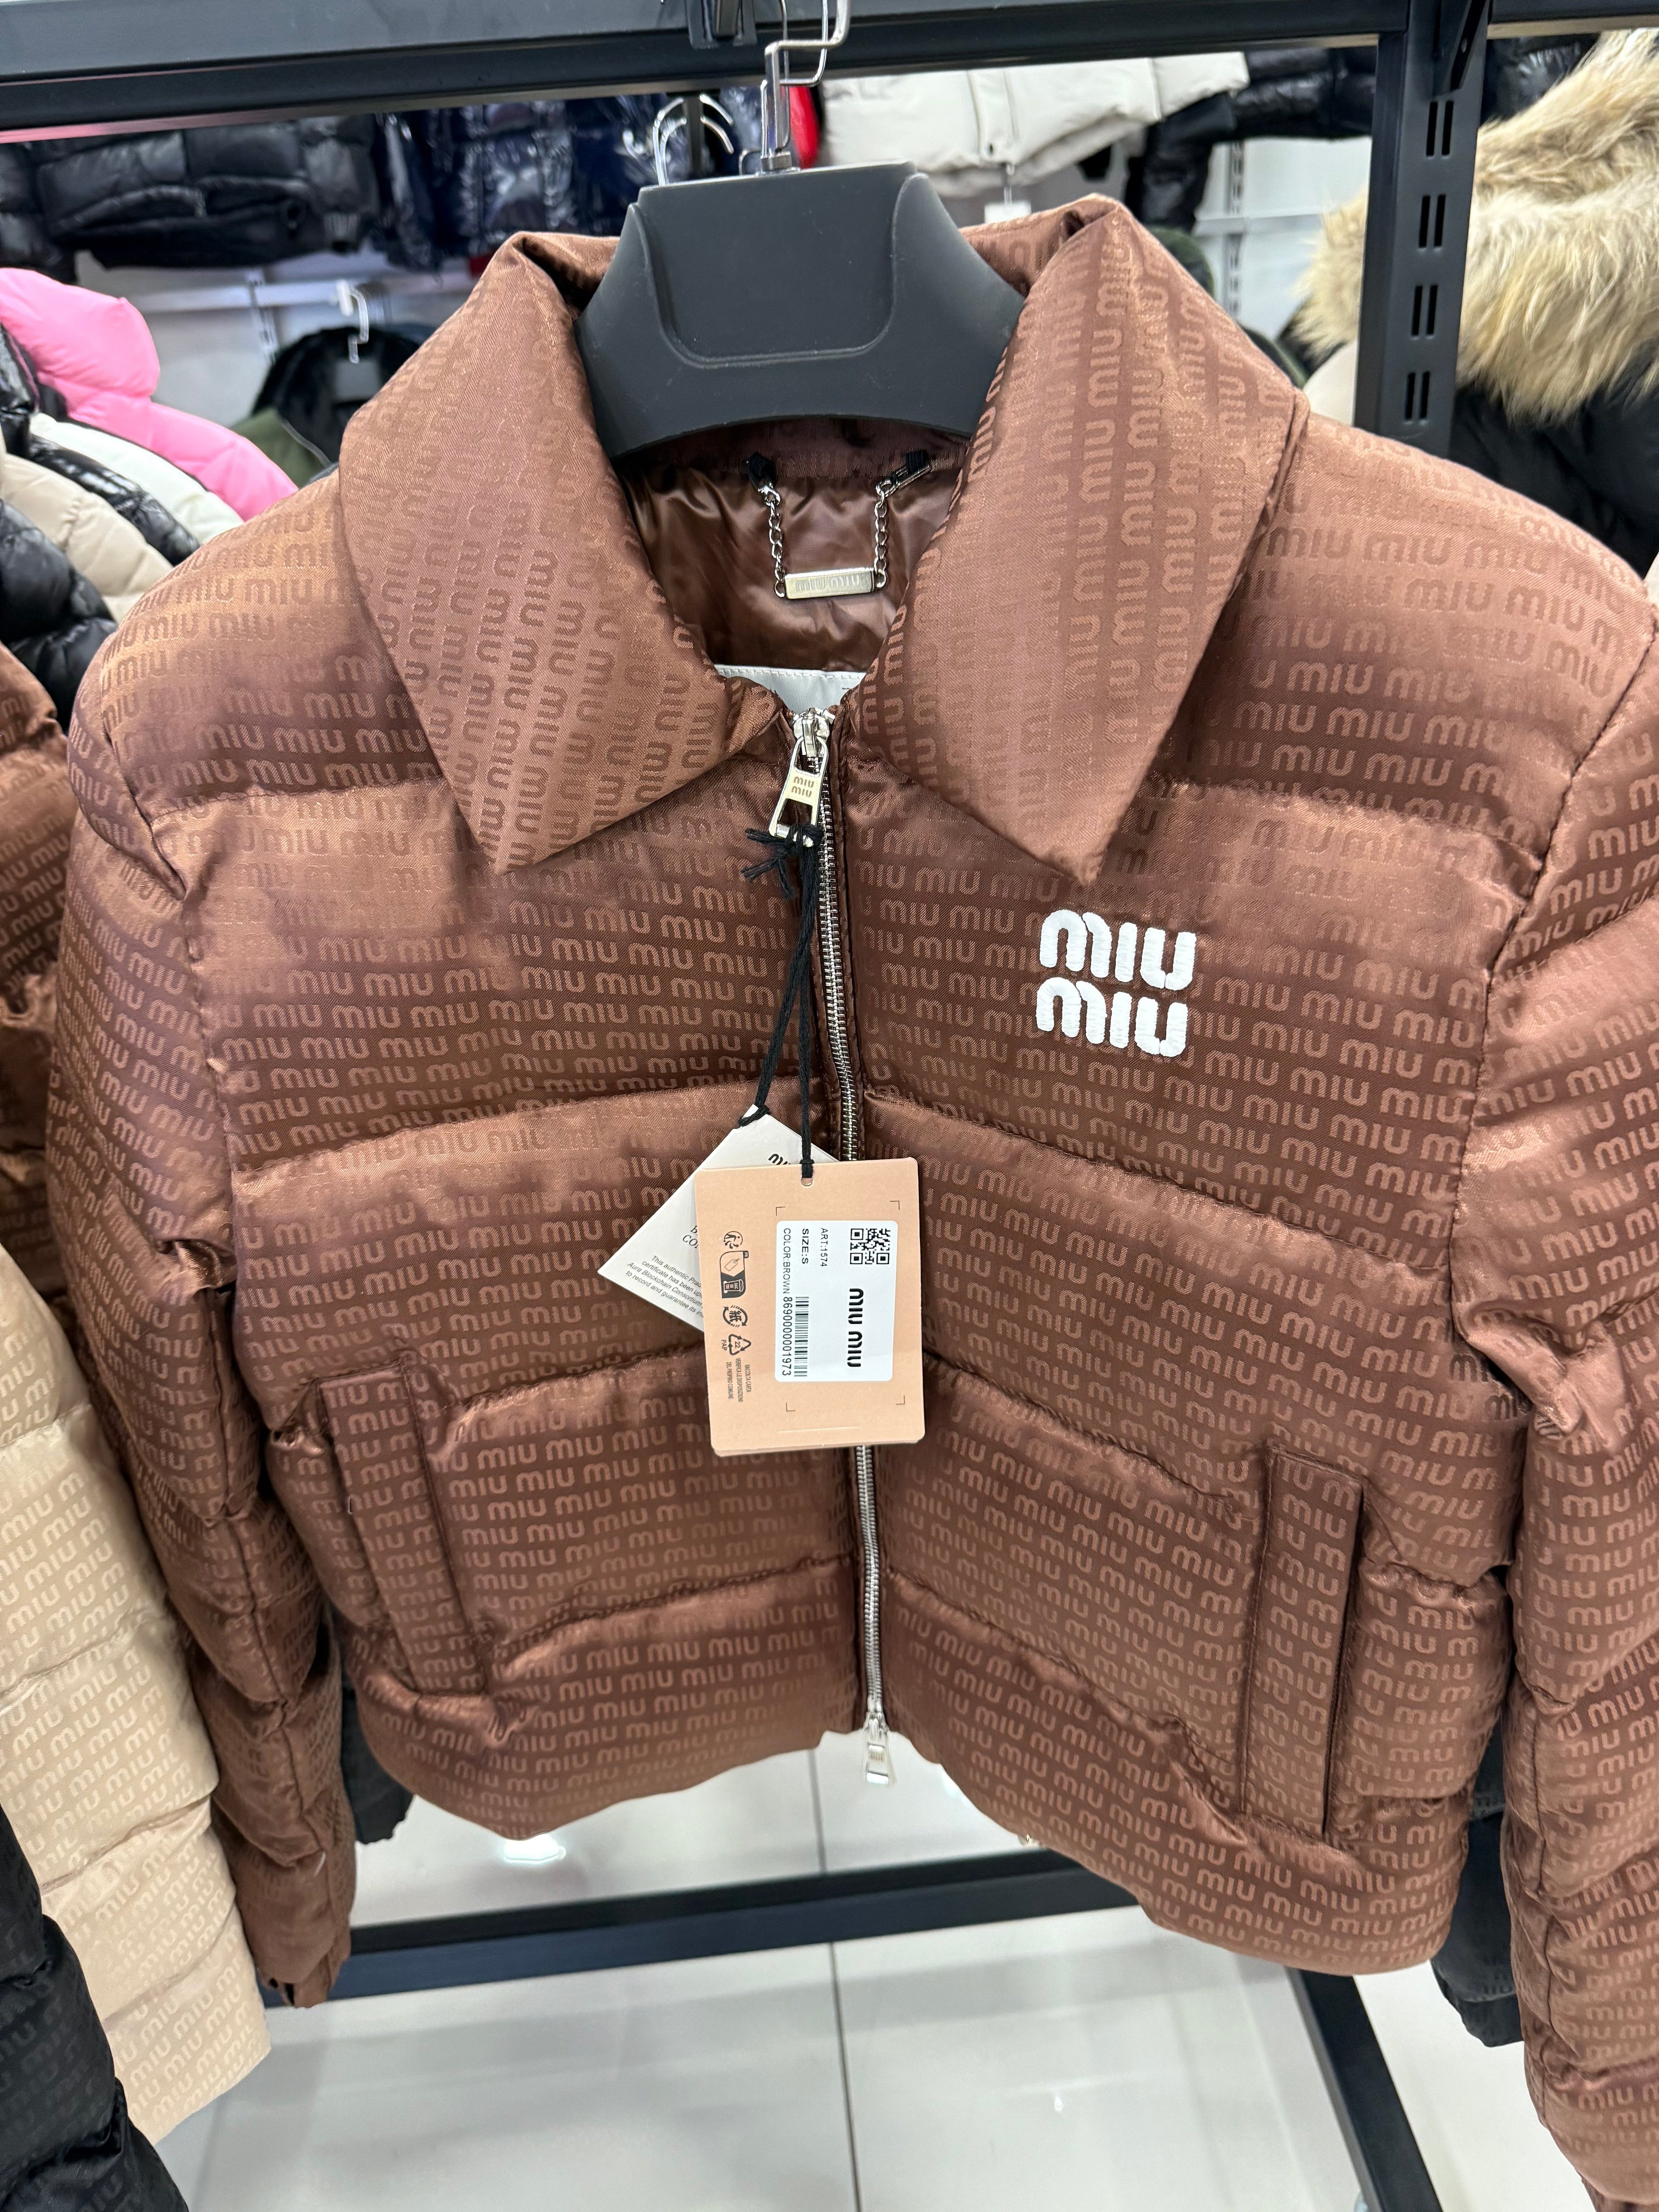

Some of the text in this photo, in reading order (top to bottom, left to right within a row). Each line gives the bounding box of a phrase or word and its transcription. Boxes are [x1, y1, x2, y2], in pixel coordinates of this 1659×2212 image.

[783, 1228, 791, 1294] COLOR:BROWN
[820, 1228, 828, 1267] ART:1574
[627, 1262, 702, 1306] Aura Blockchain Consortium
[642, 1261, 668, 1278] certificate
[668, 1275, 679, 1284] has
[680, 1281, 693, 1292] been
[652, 1255, 664, 1265] This
[664, 1264, 689, 1280] authentic
[632, 1275, 652, 1287] record
[651, 1285, 663, 1294] and
[661, 1292, 689, 1308] guarantee
[782, 1297, 792, 1376] 8690000001973
